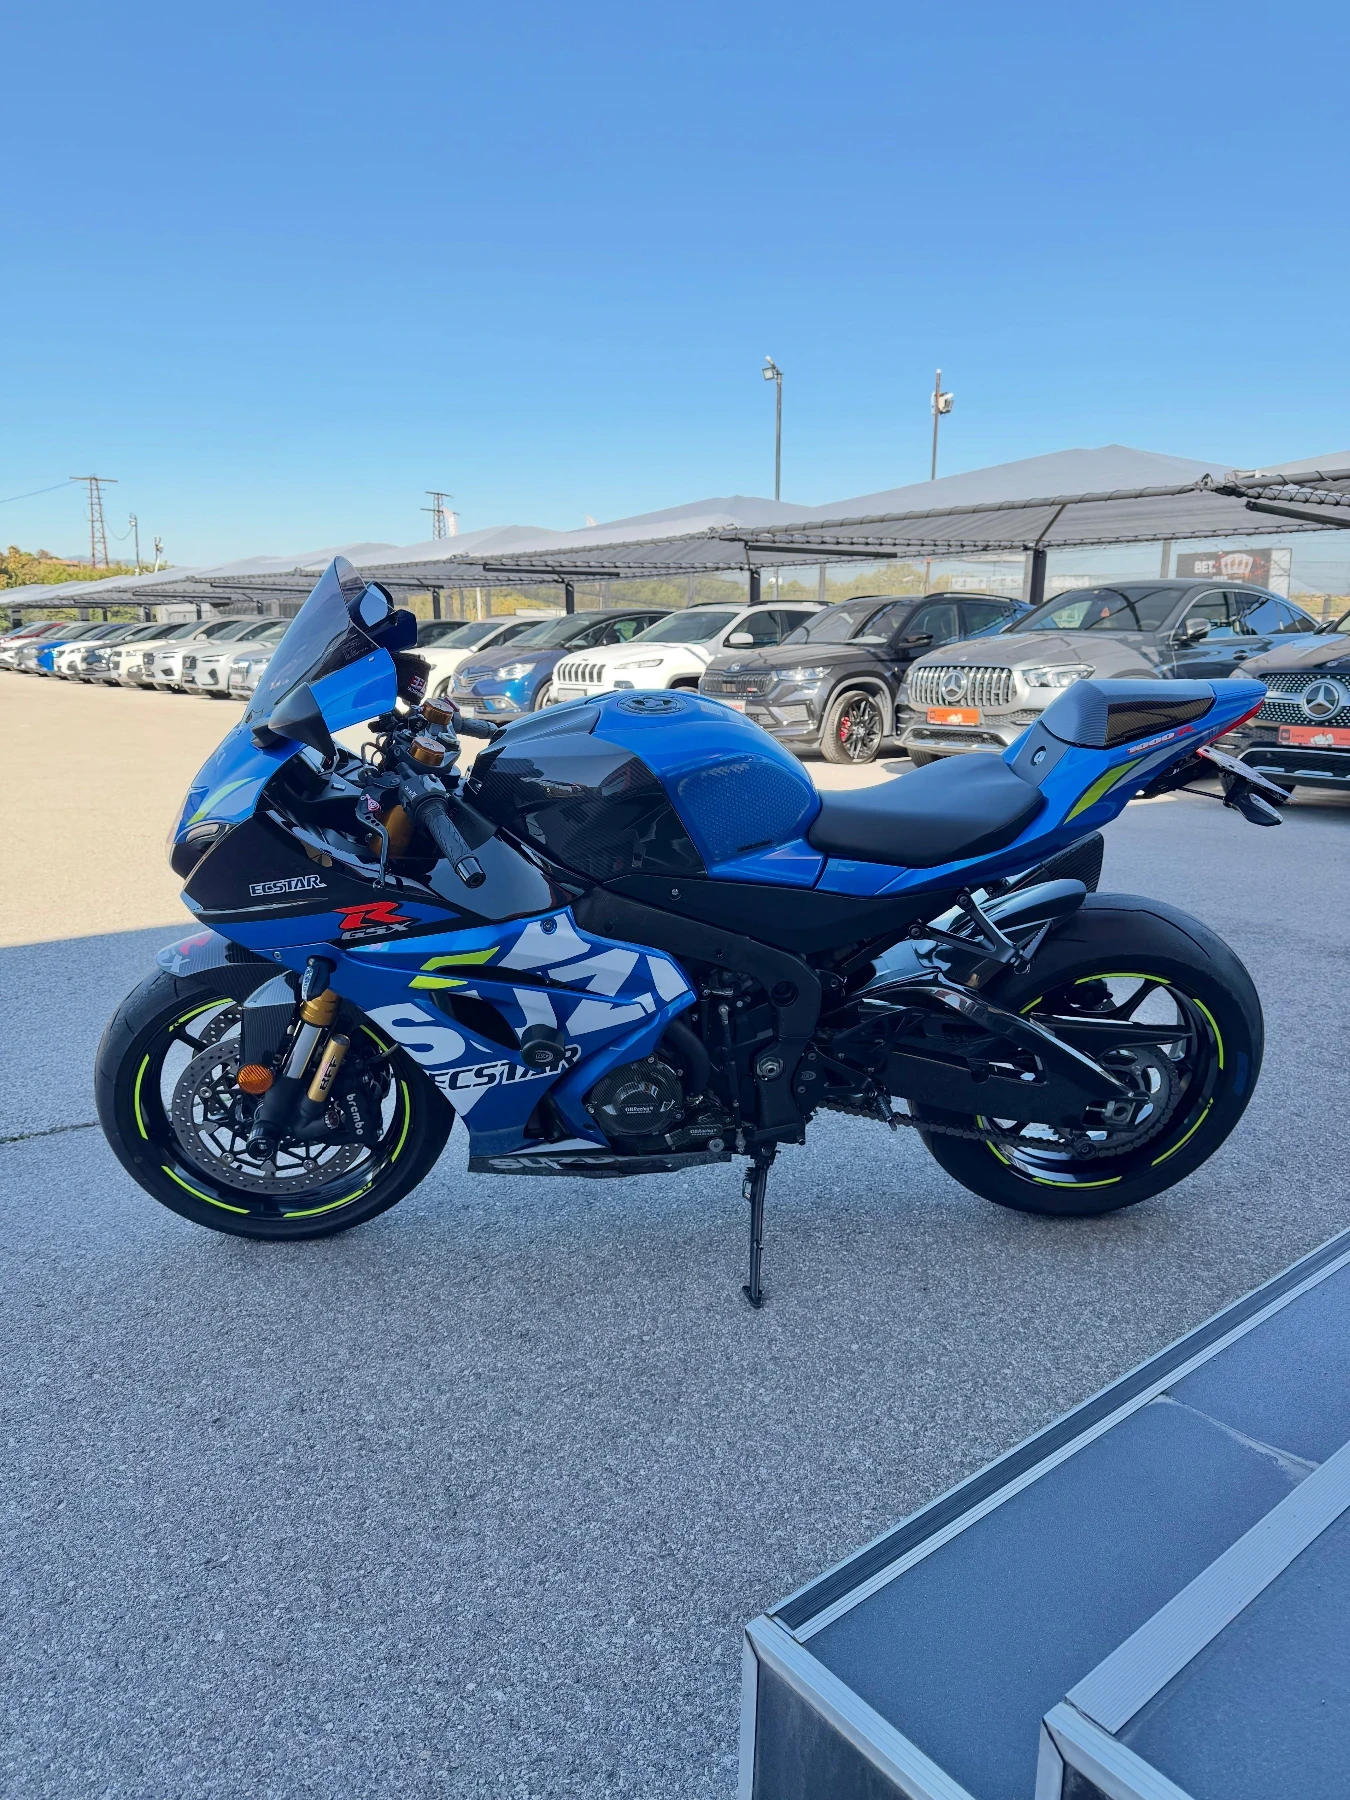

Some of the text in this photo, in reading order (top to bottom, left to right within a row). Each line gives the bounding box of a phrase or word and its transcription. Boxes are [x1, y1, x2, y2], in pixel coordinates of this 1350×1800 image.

[249, 875, 327, 896] ECSTAR
[332, 901, 412, 929] R
[341, 920, 413, 940] GSX
[346, 1093, 365, 1136] brembo
